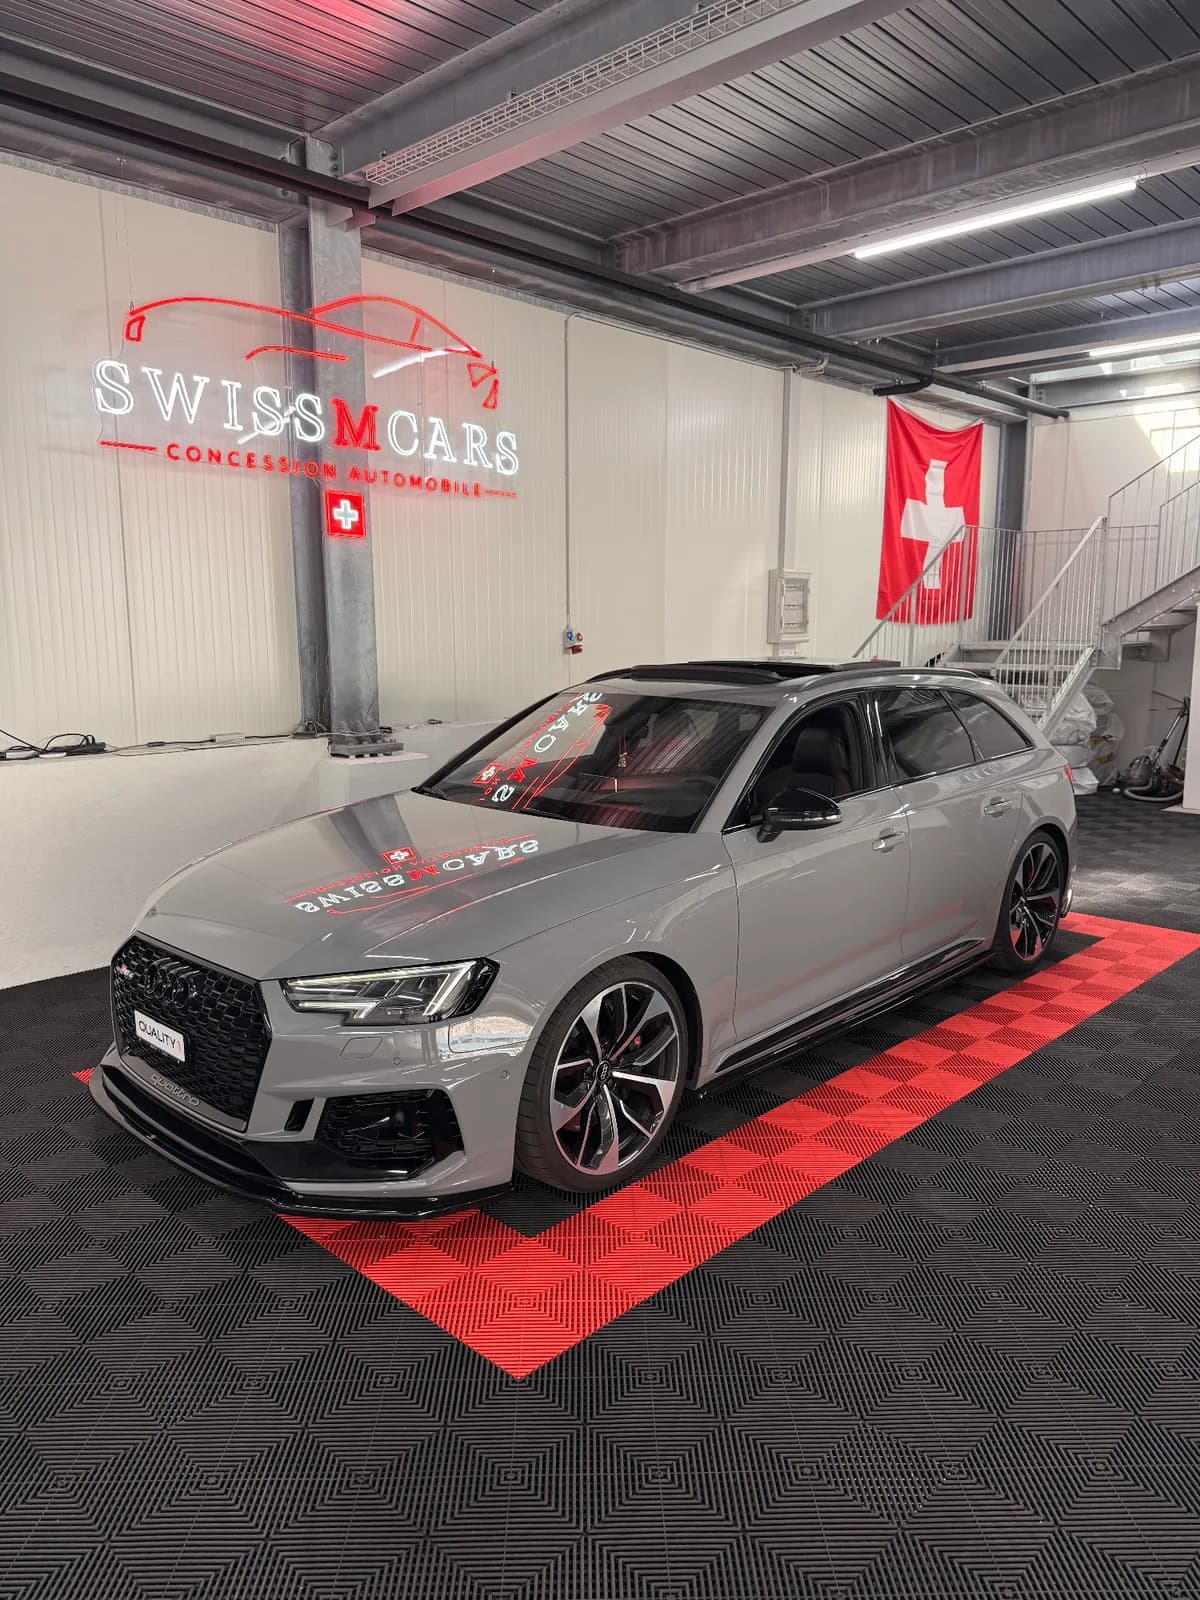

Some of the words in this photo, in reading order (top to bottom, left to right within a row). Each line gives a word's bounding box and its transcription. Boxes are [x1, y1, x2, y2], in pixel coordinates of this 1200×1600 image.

[94, 359, 518, 476] SWISSMCARS
[166, 443, 337, 480] CONCESSION
[350, 466, 483, 498] AUTOMOBILE
[151, 1073, 200, 1106] quattro
